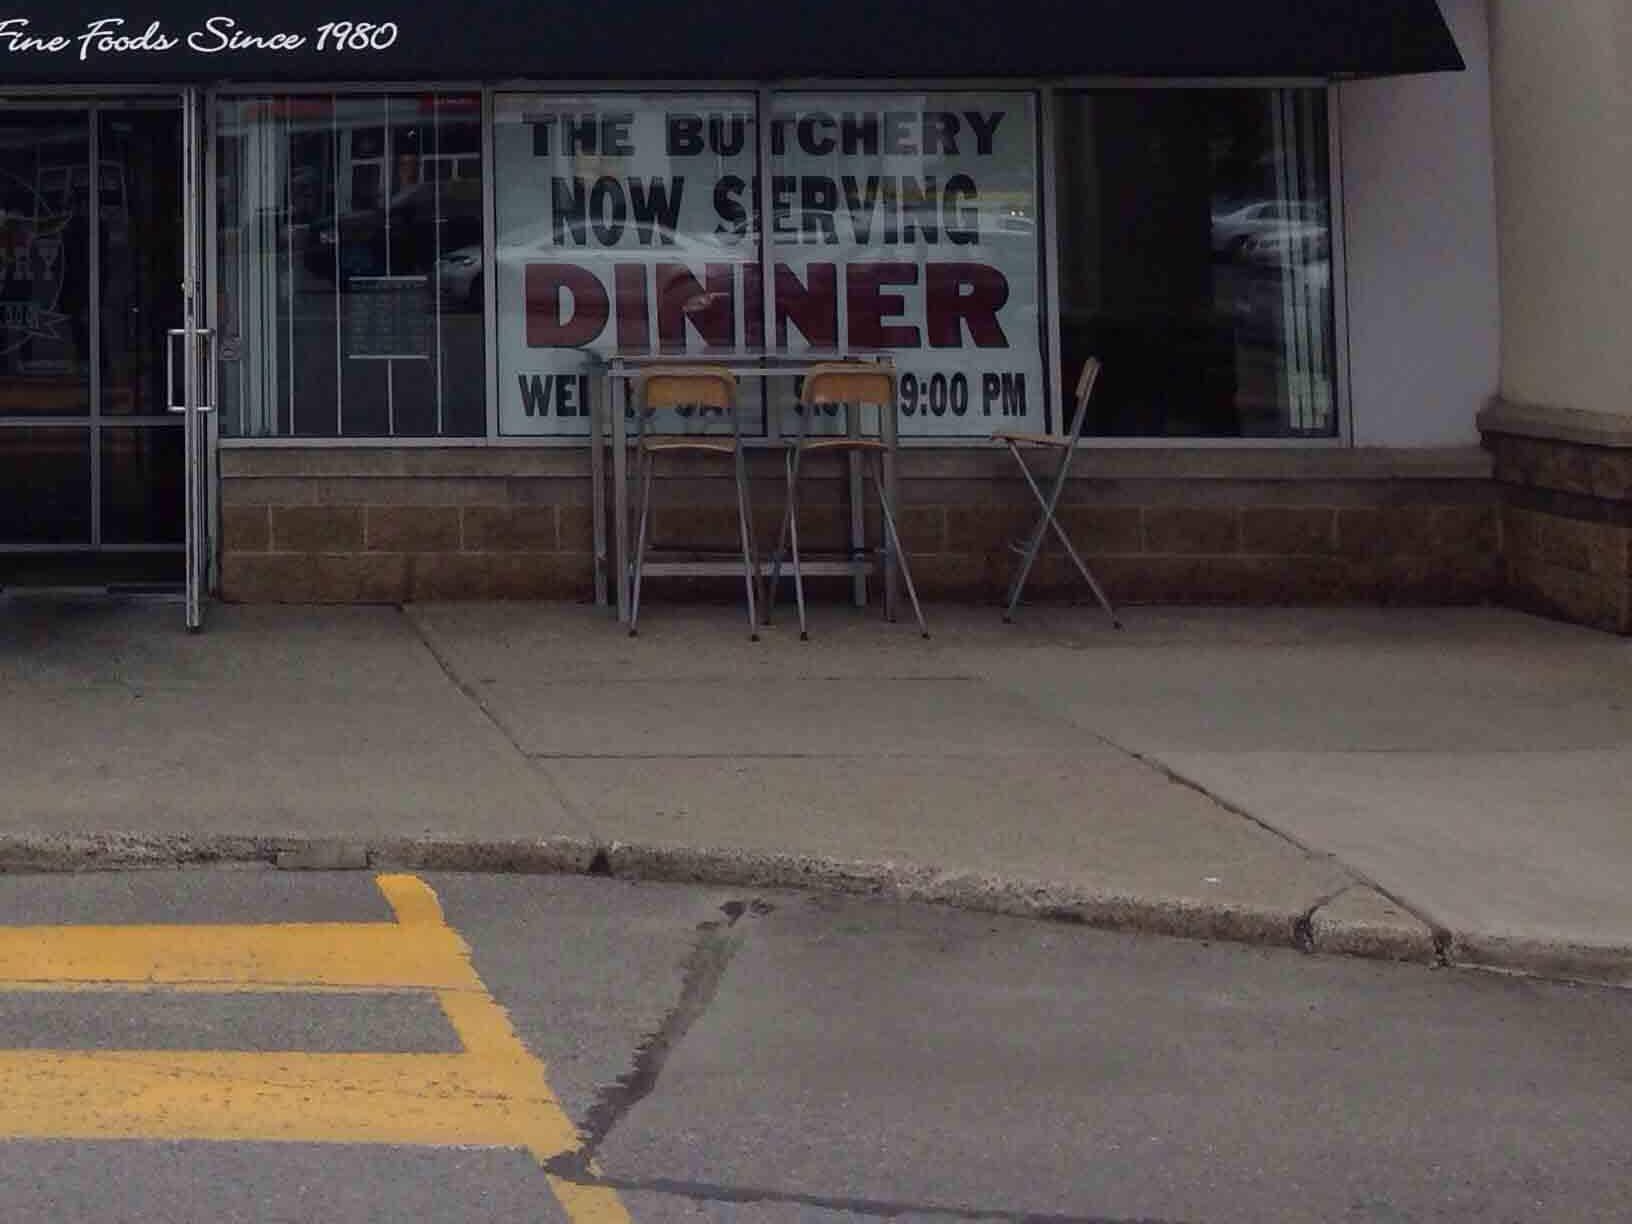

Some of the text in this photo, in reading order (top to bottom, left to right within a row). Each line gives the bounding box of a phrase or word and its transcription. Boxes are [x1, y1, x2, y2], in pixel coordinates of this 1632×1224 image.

[77, 18, 179, 61] Foods
[187, 16, 307, 52] Since
[316, 21, 399, 51] 1980
[521, 110, 1006, 157] THE BUTCHERY
[549, 173, 980, 247] NOW SERVING
[524, 262, 1010, 350] DINNER
[899, 372, 969, 418] 9:00
[982, 373, 1028, 418] PM
